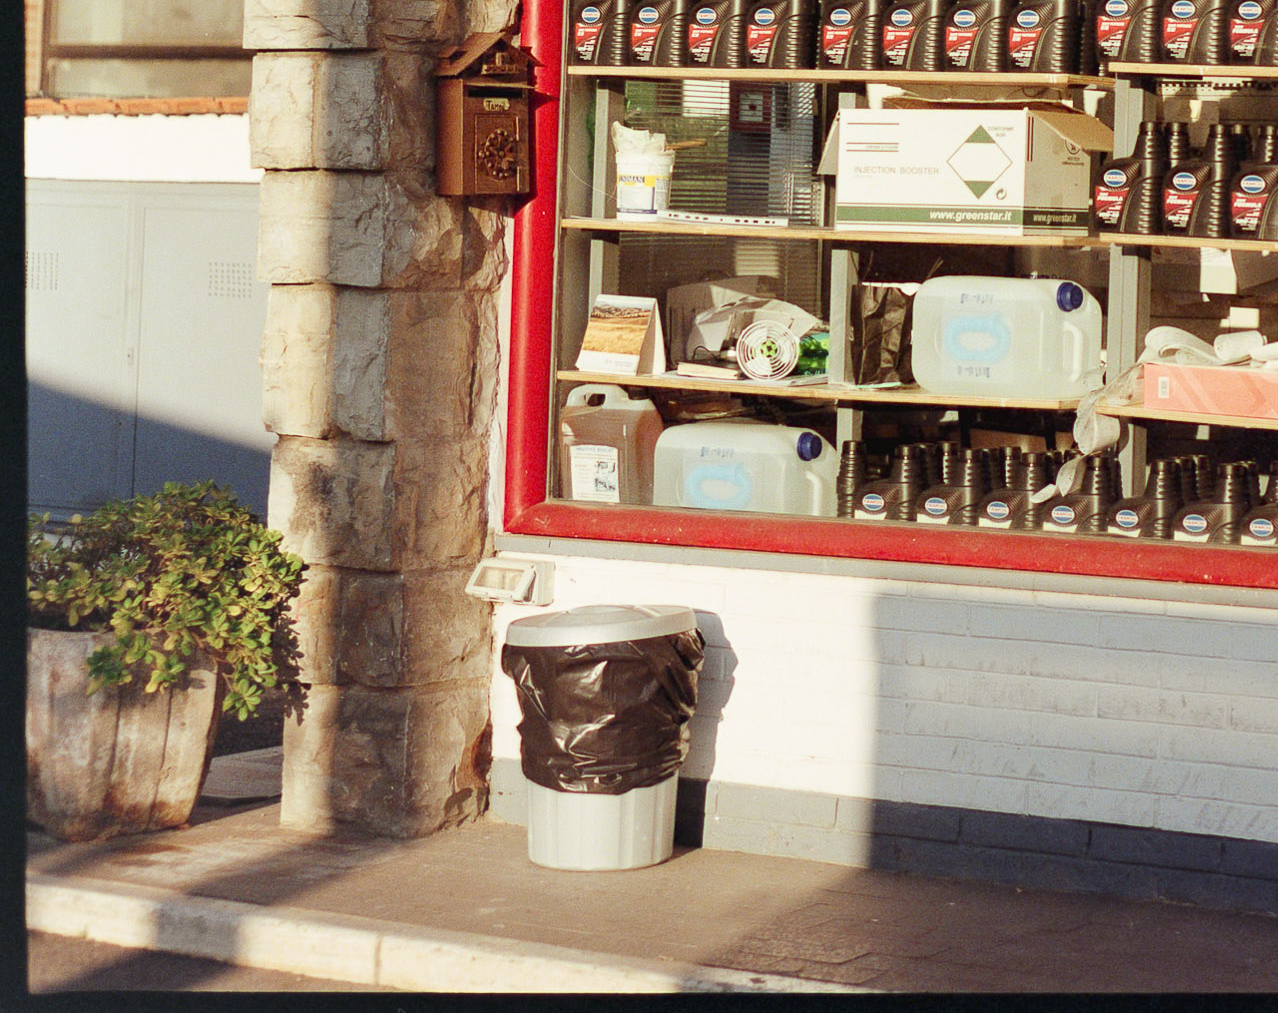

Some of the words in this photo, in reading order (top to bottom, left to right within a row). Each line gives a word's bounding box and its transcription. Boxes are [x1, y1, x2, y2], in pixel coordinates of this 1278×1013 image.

[854, 166, 896, 174] INJECTION
[900, 166, 939, 175] BOOSTER
[929, 210, 1012, 222] www.greenstar.it
[1032, 212, 1077, 224] www.greenstar.it
